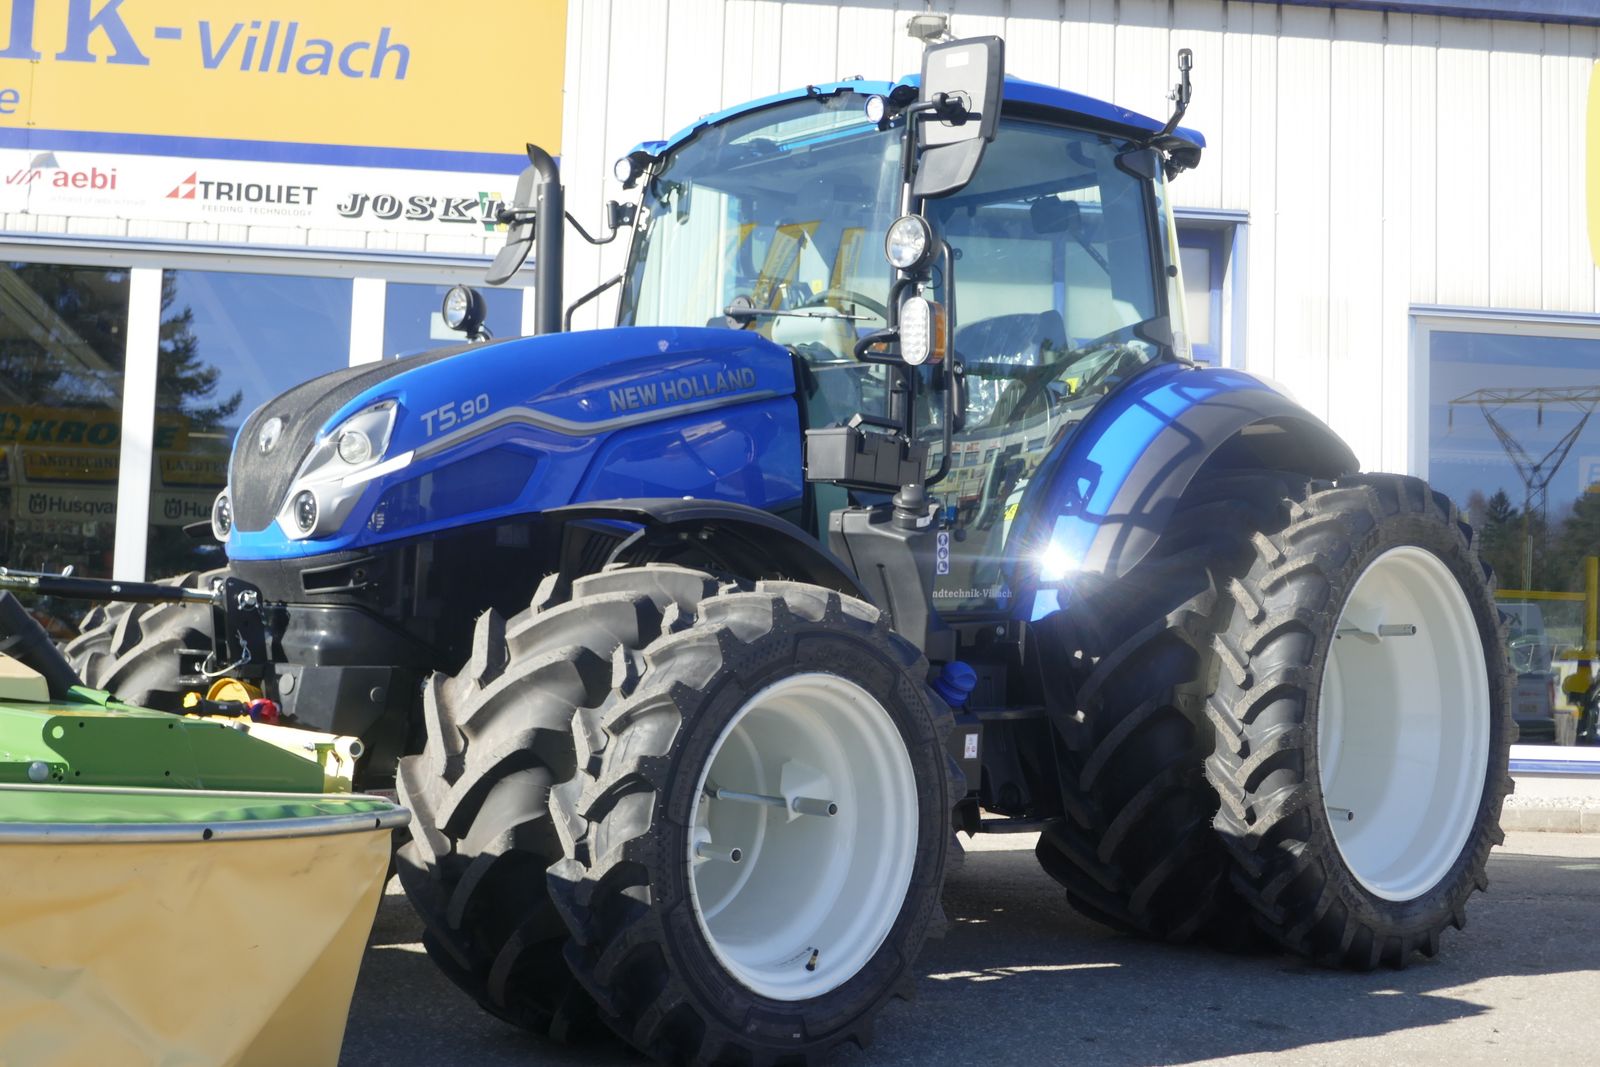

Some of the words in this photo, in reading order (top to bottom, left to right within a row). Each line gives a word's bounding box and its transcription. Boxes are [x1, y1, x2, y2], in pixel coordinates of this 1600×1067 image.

[52, 166, 117, 191] aebi
[199, 180, 318, 206] TRIOLIET
[202, 204, 244, 214] FEEDING
[249, 206, 313, 217] TECHNOLOGY
[336, 192, 507, 225] JOSKI
[608, 387, 657, 413] NEW
[660, 367, 757, 403] HOLLAND
[420, 393, 490, 437] T5.90
